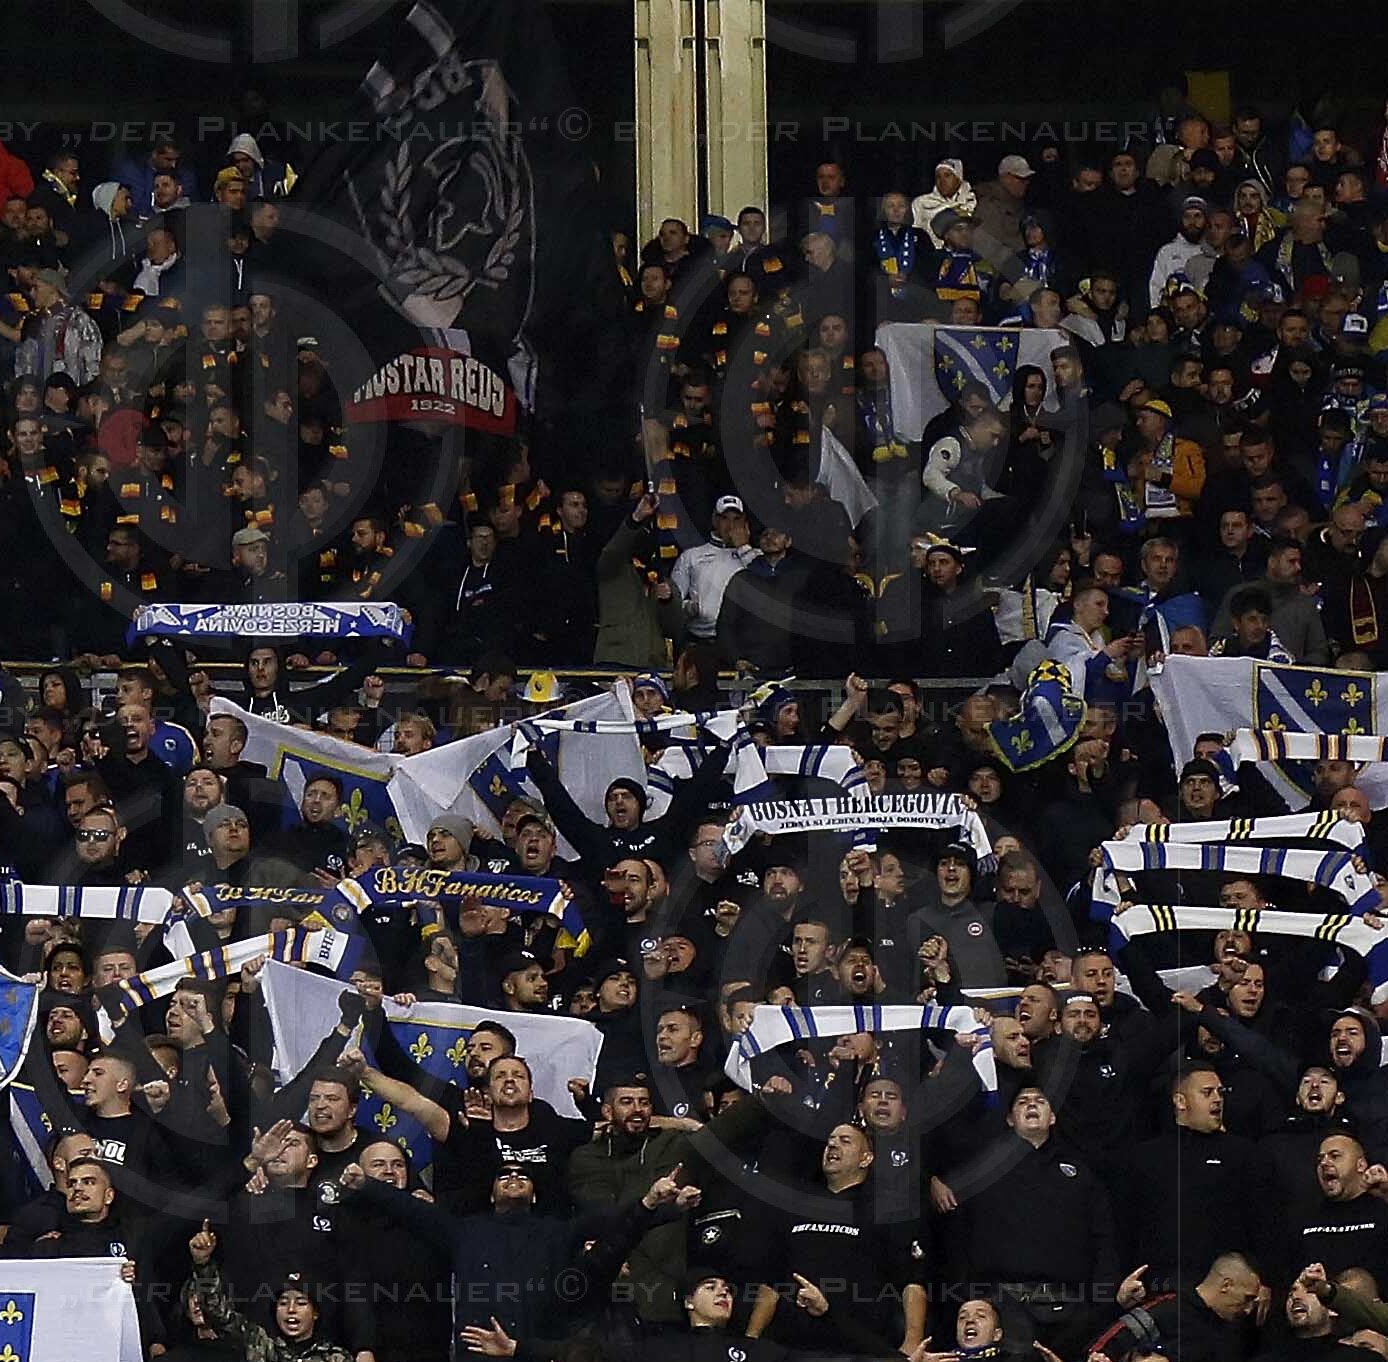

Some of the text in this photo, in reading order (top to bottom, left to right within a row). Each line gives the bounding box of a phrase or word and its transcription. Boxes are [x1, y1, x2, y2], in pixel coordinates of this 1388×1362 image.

[410, 399, 456, 415] 1922
[749, 799, 816, 822] BOSNA
[373, 866, 544, 905] BHFanaticos
